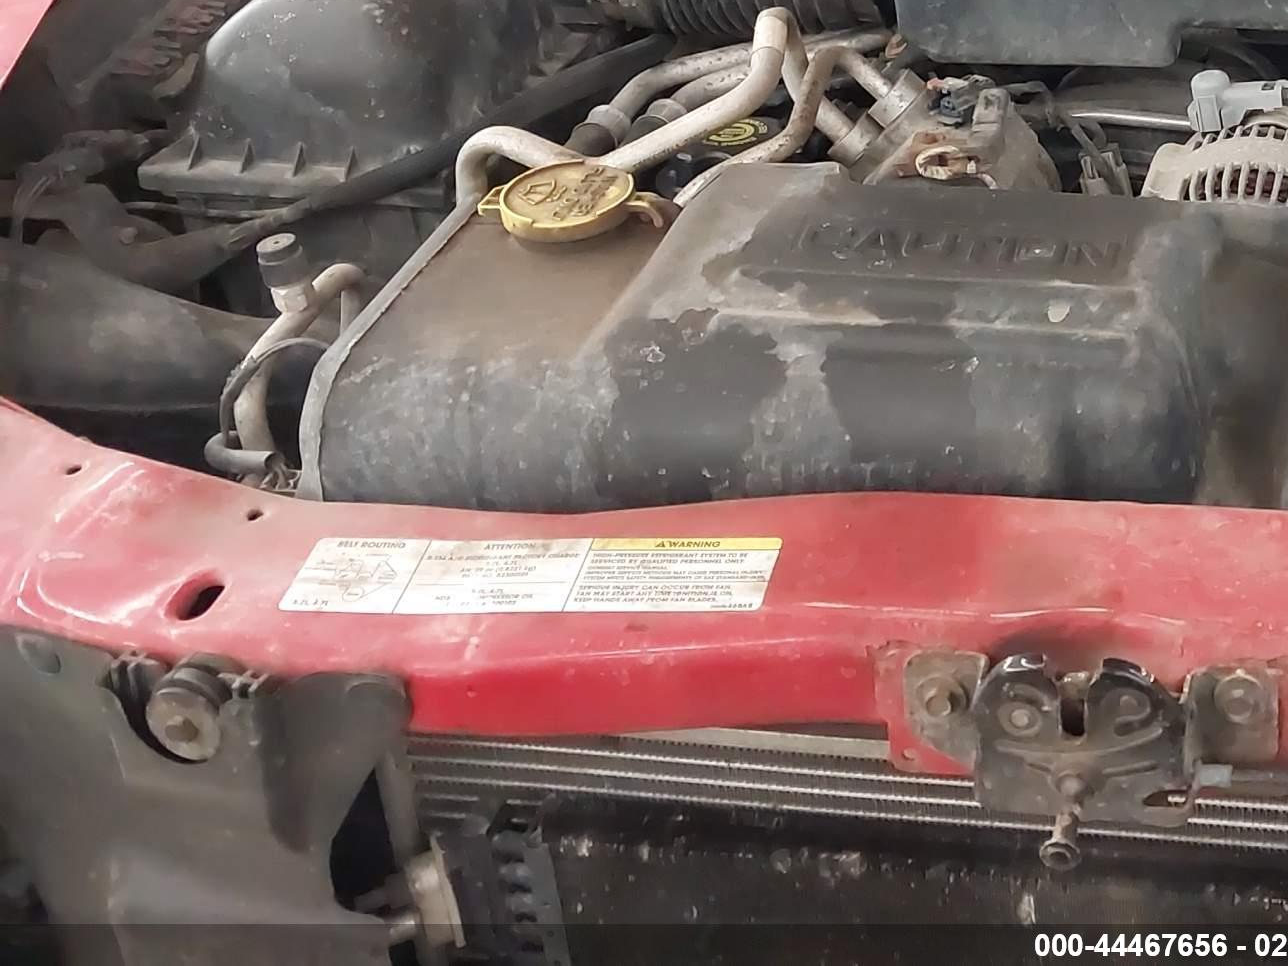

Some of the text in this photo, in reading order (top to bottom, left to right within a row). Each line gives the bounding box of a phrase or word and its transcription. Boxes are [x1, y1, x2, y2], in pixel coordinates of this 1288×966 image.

[798, 222, 1126, 269] CAUTION
[360, 541, 407, 549] ROUTING
[484, 542, 537, 551] ATTENTION
